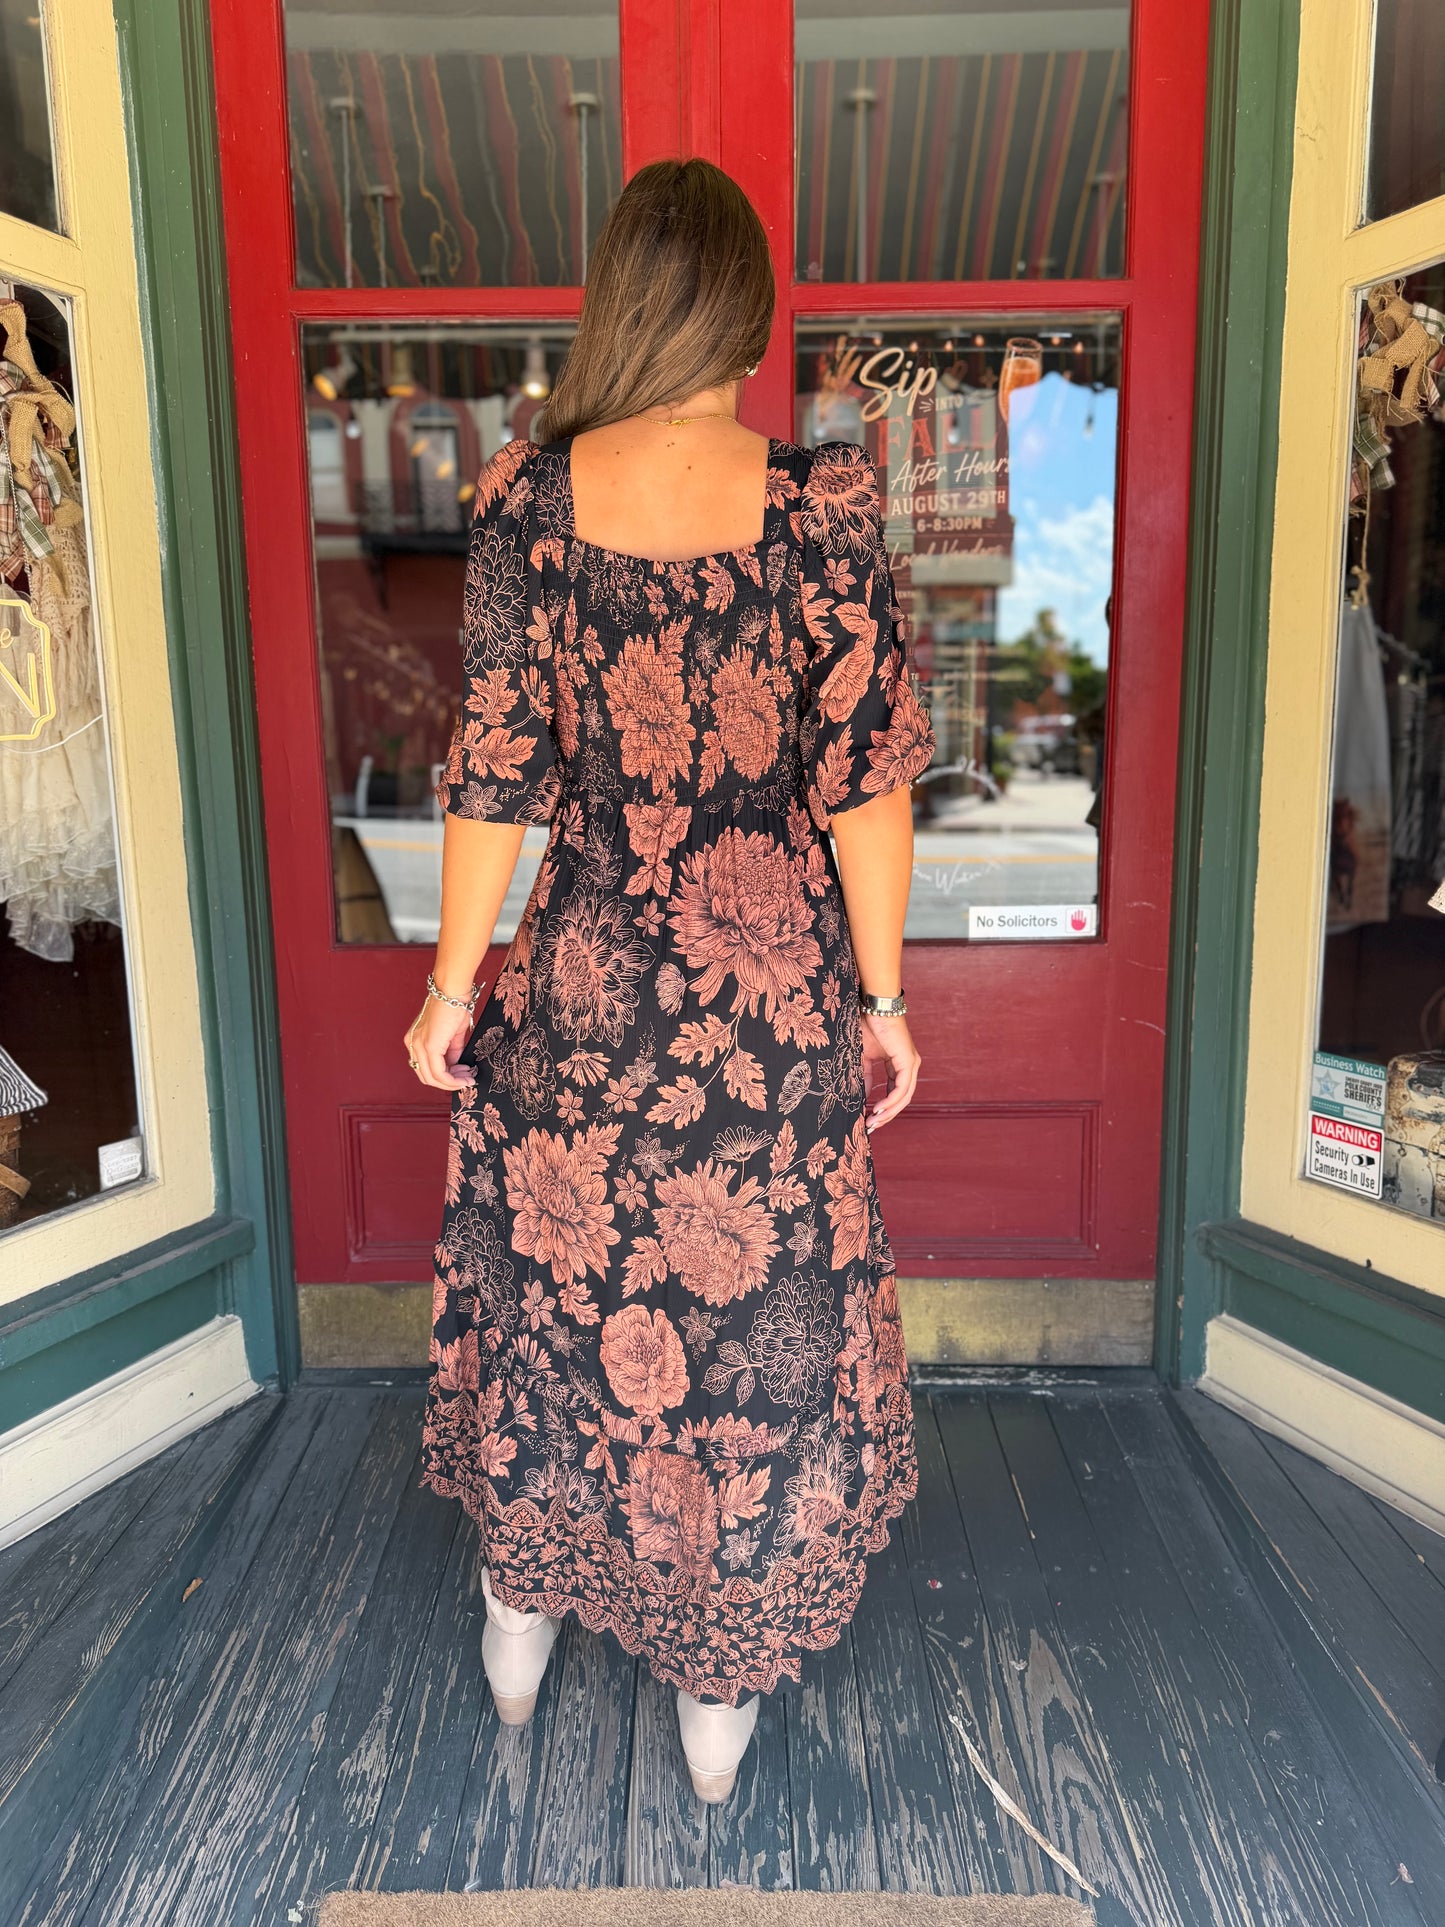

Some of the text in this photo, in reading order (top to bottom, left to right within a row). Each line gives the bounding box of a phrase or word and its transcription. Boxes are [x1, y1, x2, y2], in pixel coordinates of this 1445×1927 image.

[859, 346, 938, 423] Sip
[935, 395, 964, 411] INTO
[875, 406, 998, 469] FALL
[890, 456, 947, 493] After
[891, 490, 1006, 516] AUGUST 29TH
[916, 517, 983, 533] 6-8:30PM
[976, 914, 1058, 928] No Solicitors
[1315, 1053, 1385, 1079] Business Watch
[1345, 1081, 1383, 1097] POLK COUNTY
[1314, 1118, 1378, 1149] WARNING
[1314, 1140, 1350, 1166] Security
[1314, 1158, 1375, 1190] Cameras In Use
